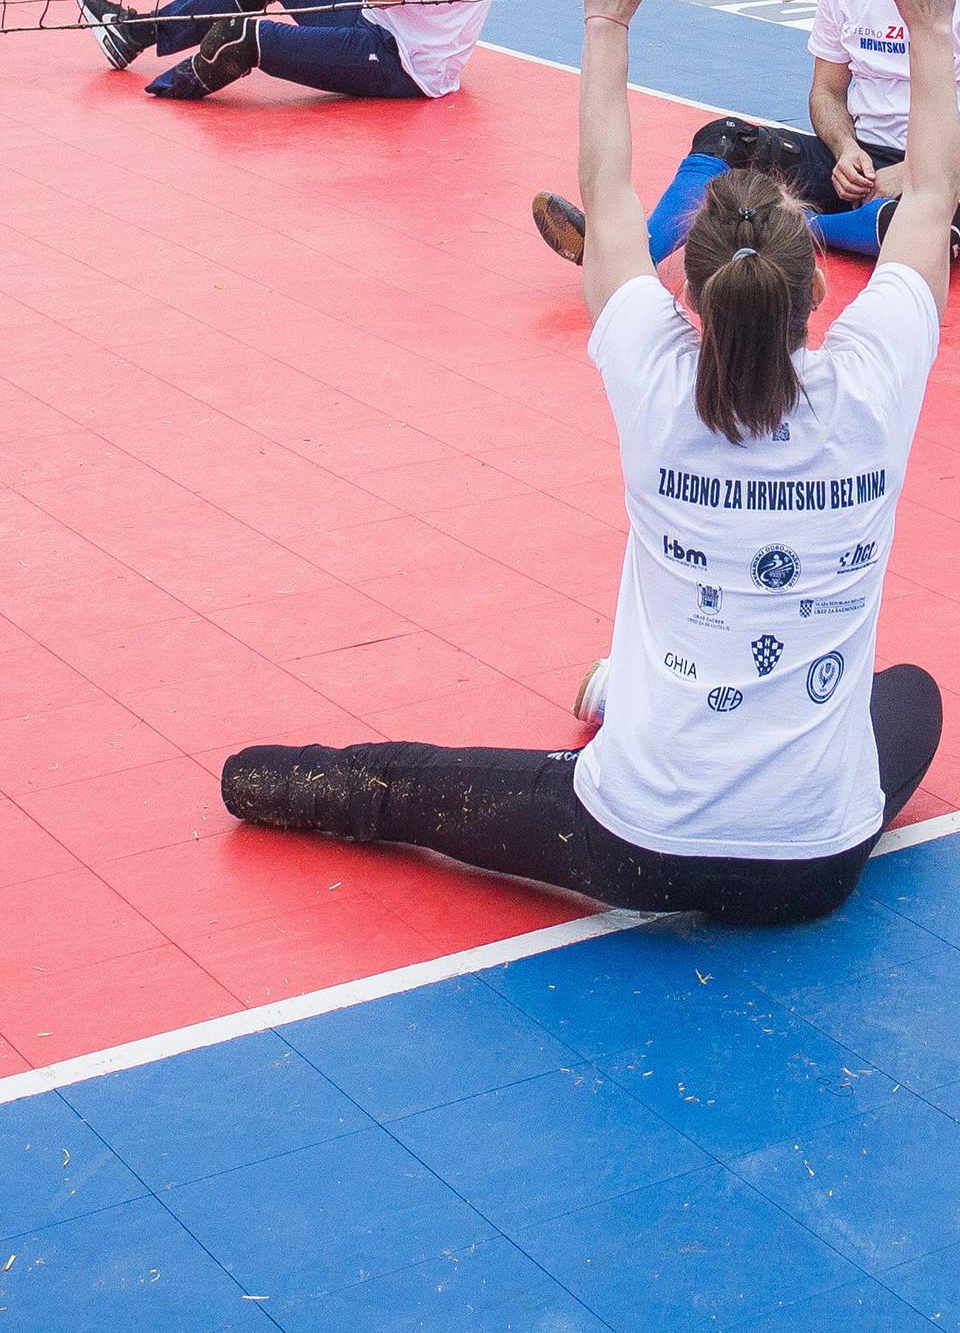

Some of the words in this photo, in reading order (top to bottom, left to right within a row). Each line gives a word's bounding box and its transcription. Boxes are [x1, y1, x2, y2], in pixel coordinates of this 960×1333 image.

[886, 26, 904, 39] ZA
[860, 38, 906, 54] HRVATSKU
[659, 468, 720, 508] ZAJEDNO
[723, 479, 743, 510] ZA
[746, 480, 826, 511] HRVATSKU
[830, 477, 854, 510] BEZ
[856, 469, 886, 505] MINA
[664, 652, 697, 679] GHIA
[707, 686, 743, 712] ALFA
